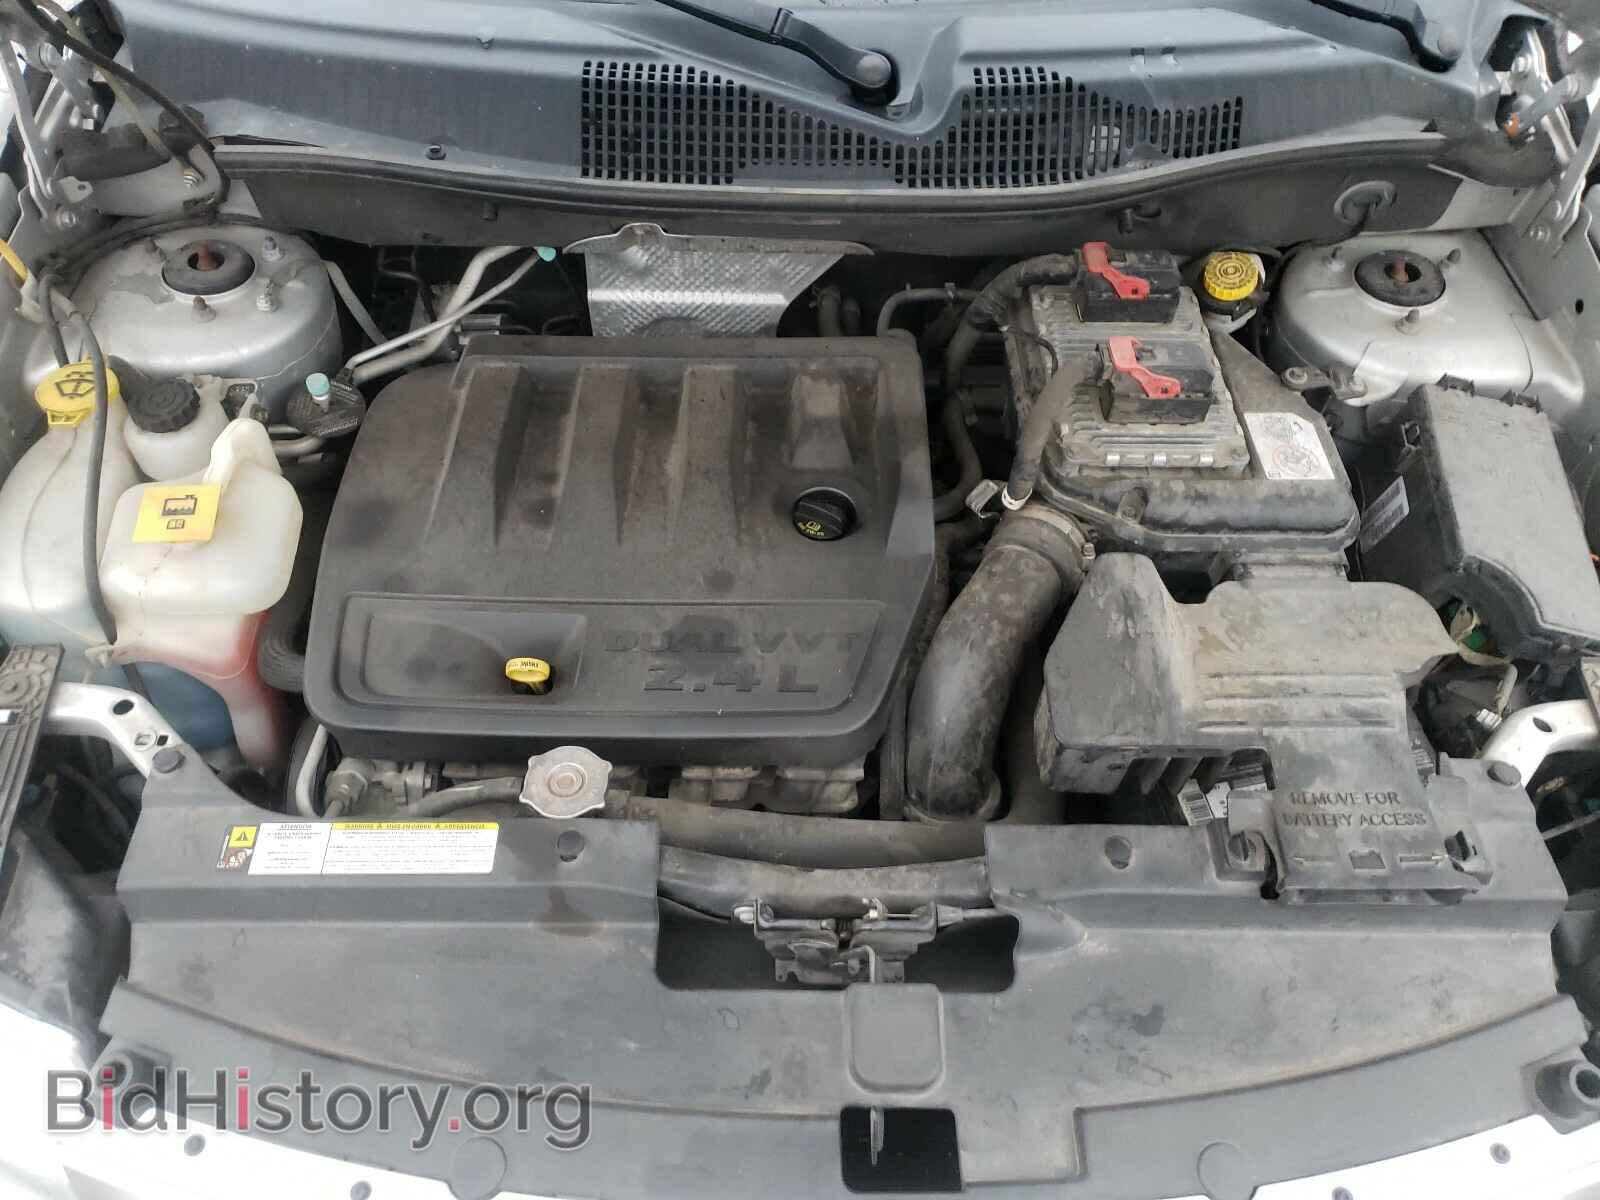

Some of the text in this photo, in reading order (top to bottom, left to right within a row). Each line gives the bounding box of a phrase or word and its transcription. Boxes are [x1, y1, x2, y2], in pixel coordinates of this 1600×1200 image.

[1289, 791, 1401, 806] REMOVE FOR
[1281, 812, 1427, 827] BATTERY ACCESS
